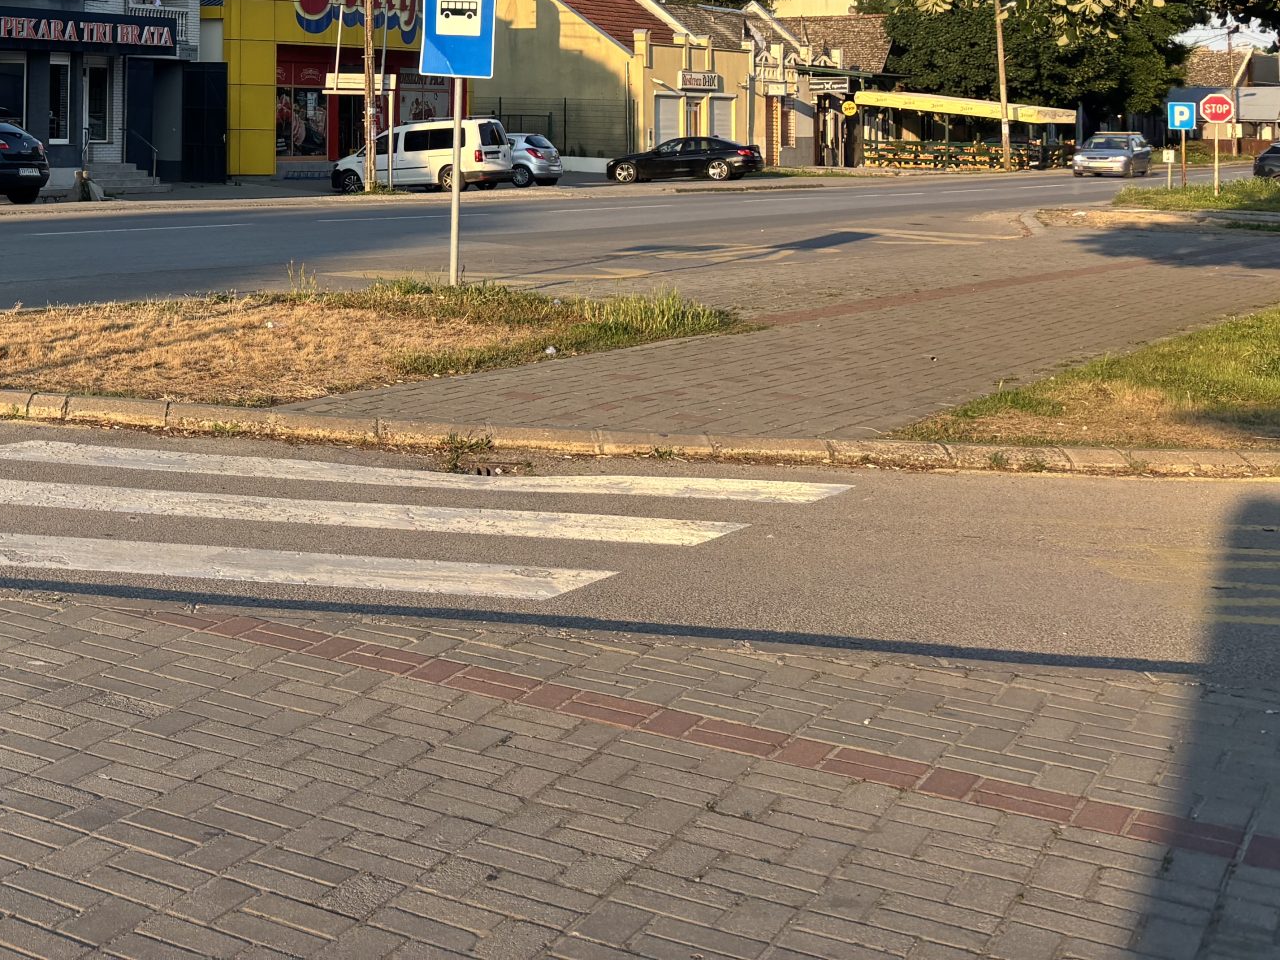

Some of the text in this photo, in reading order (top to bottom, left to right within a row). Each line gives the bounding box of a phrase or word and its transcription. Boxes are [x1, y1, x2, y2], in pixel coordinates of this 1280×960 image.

[0, 16, 174, 47] PEKARA TRI BRATA
[1174, 105, 1190, 126] P
[1204, 103, 1230, 114] STOP
